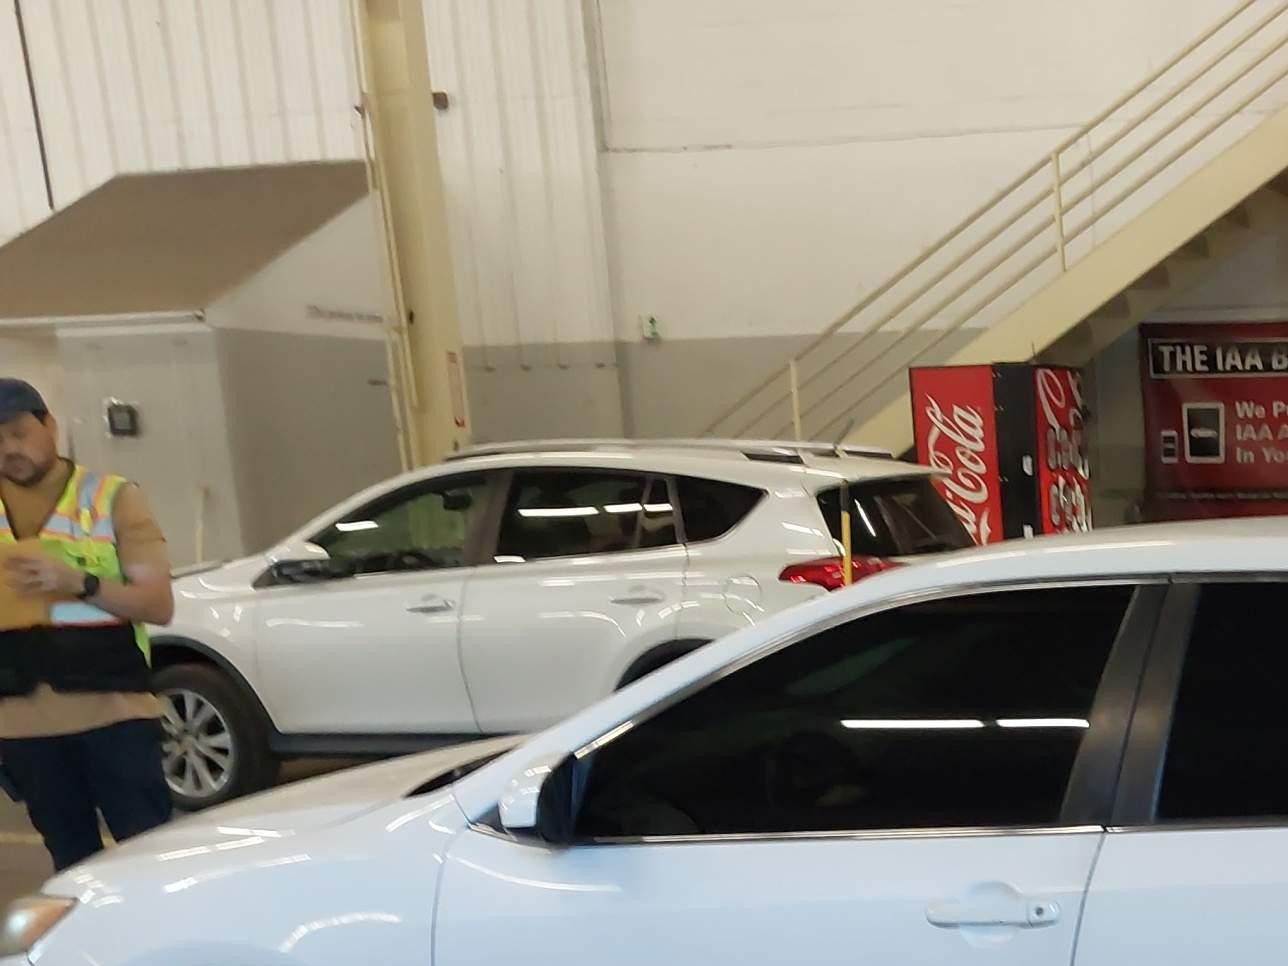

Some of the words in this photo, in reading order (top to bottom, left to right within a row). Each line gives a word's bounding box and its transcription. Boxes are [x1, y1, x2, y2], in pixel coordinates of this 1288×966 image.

[1158, 344, 1209, 373] THE
[1215, 344, 1264, 372] IAA
[1235, 400, 1266, 419] We
[1235, 423, 1273, 442] IAA
[1235, 447, 1255, 464] In
